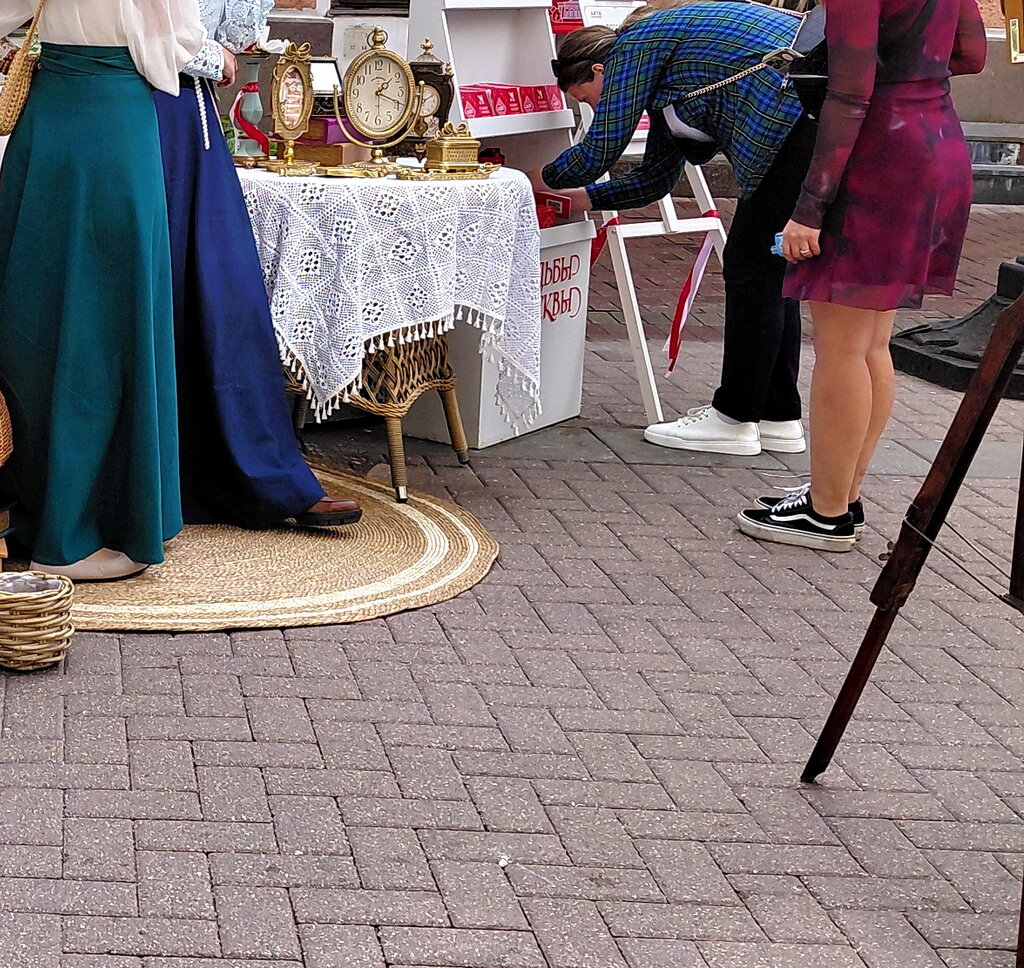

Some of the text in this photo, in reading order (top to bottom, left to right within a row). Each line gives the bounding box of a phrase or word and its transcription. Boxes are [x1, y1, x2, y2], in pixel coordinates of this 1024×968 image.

[364, 64, 372, 76] 11
[374, 59, 384, 71] 12
[356, 75, 365, 86] 10
[352, 88, 360, 99] 9
[356, 103, 363, 113] 8
[386, 111, 393, 122] 5
